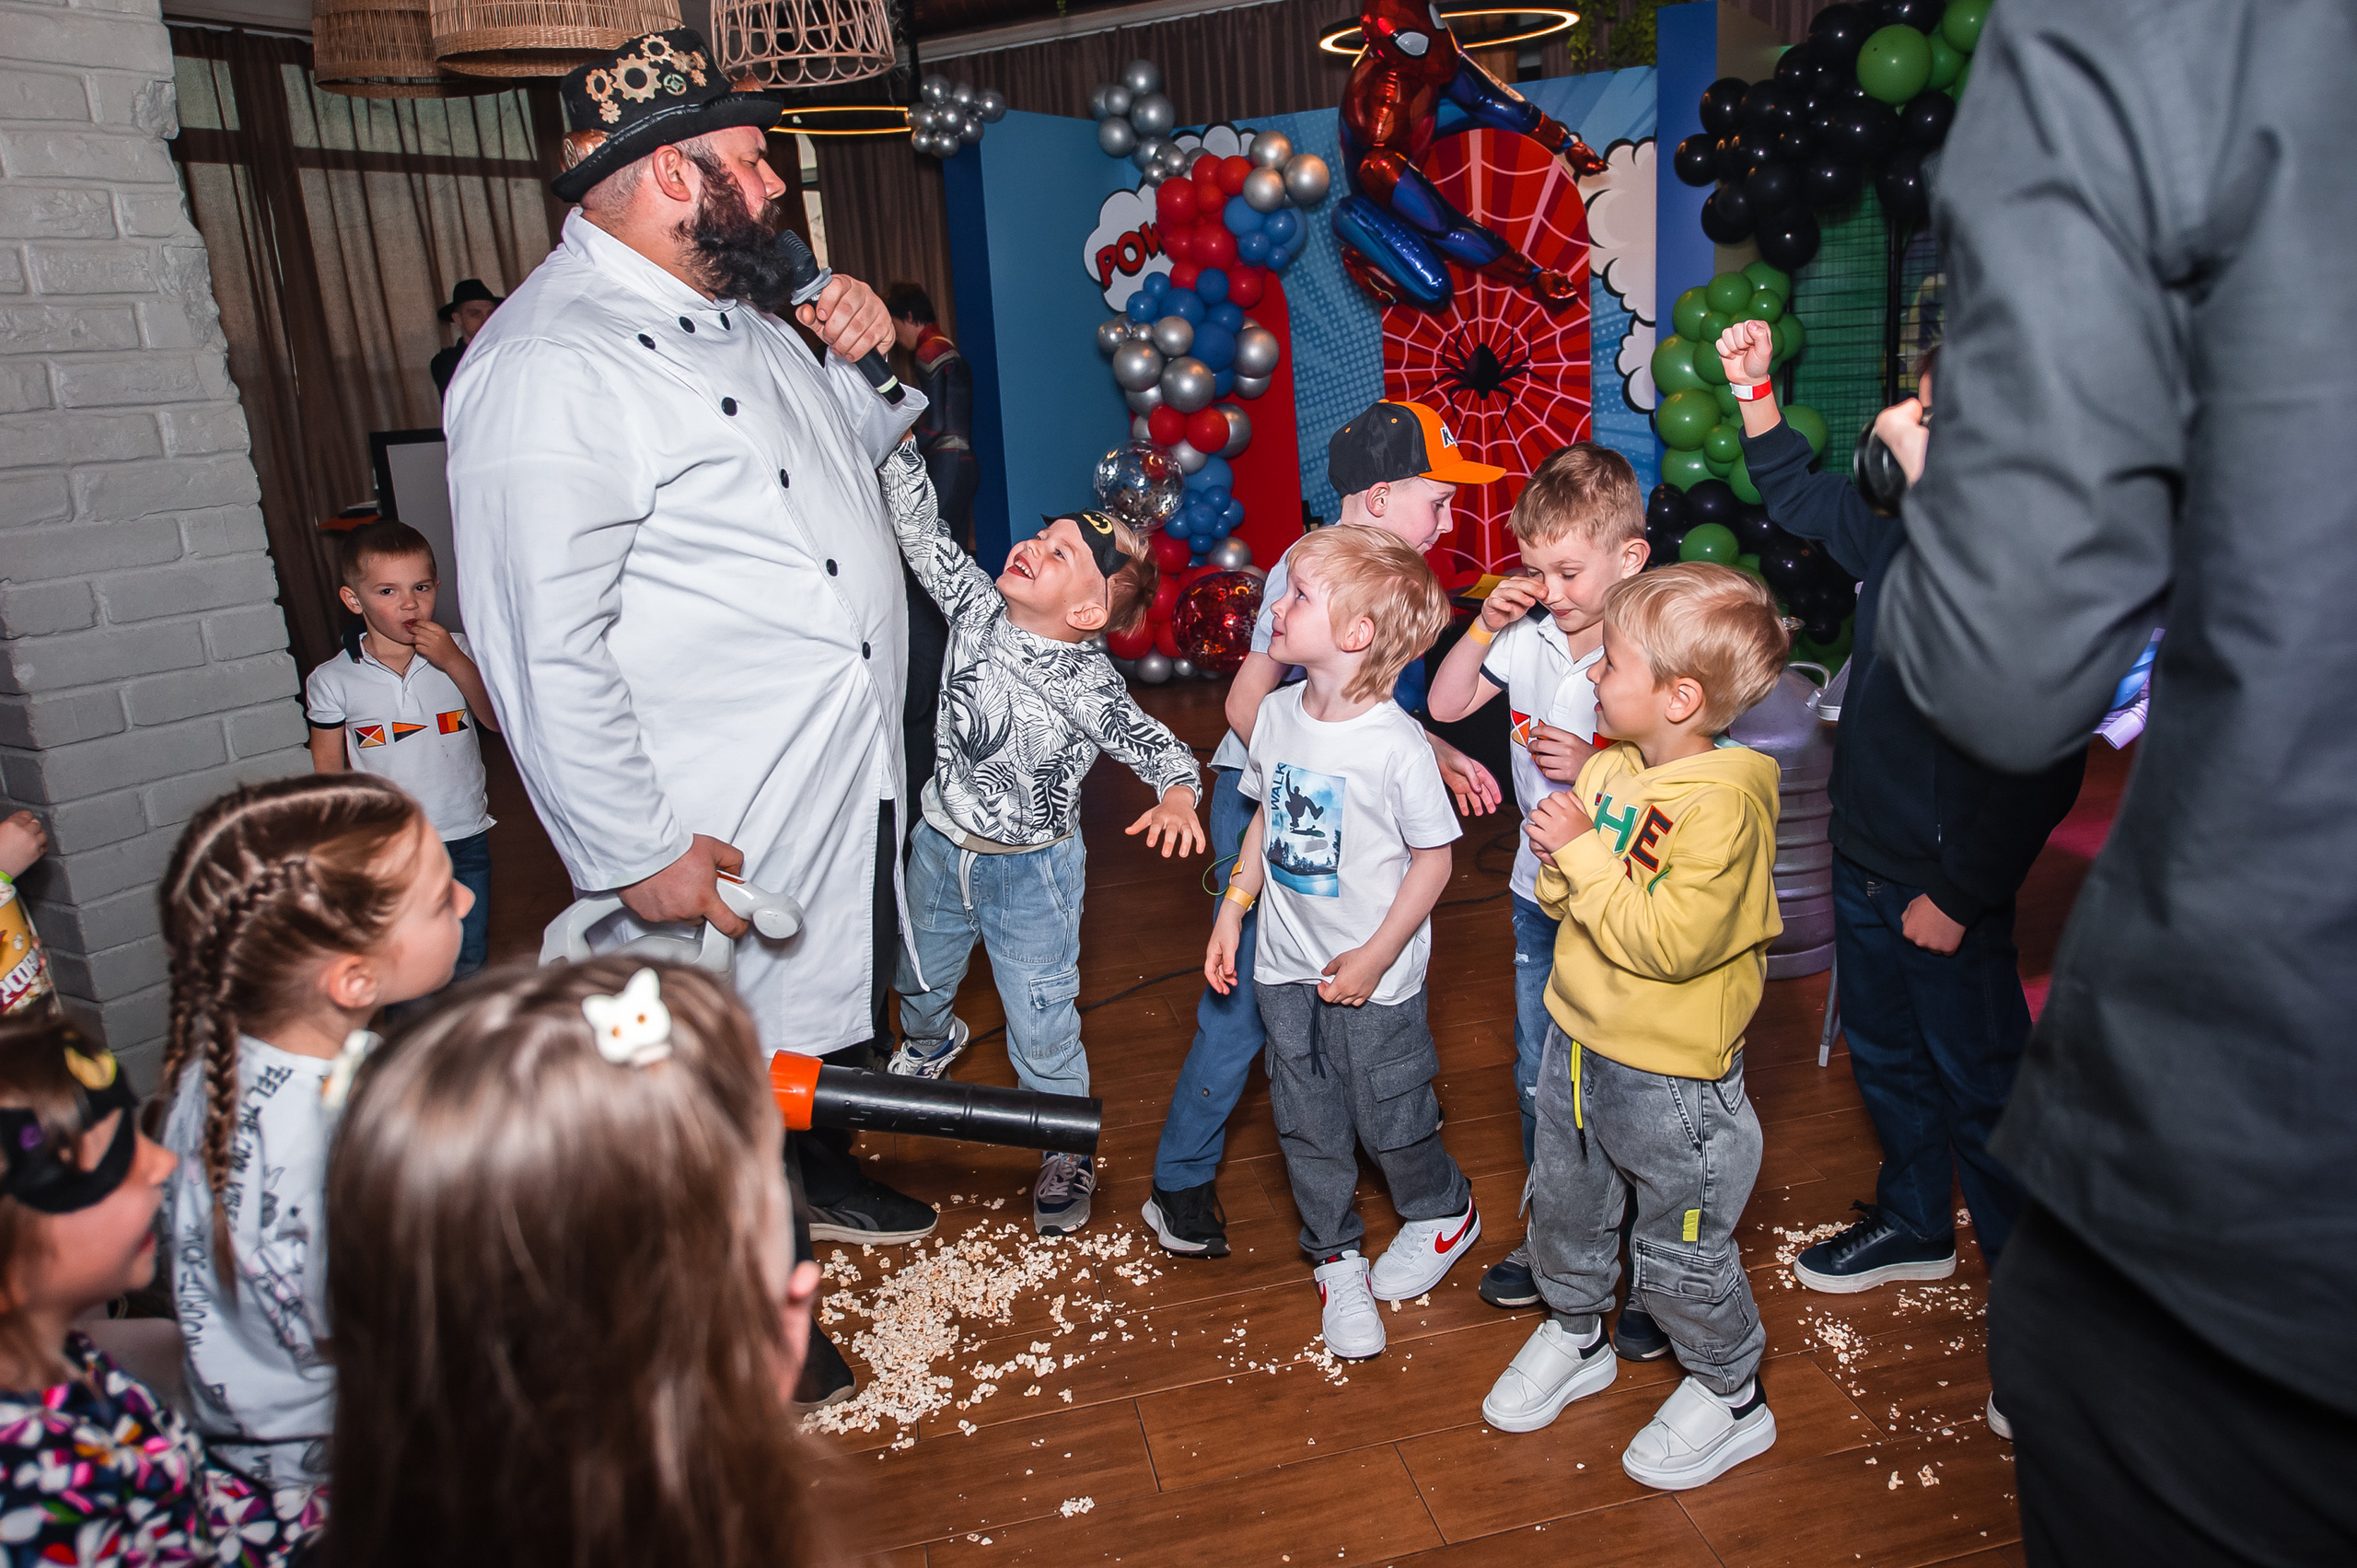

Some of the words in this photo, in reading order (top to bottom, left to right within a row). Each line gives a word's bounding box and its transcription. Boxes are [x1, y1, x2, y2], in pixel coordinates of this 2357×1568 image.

[1096, 221, 1166, 293] POW
[1271, 762, 1287, 811] WALK
[1594, 793, 1673, 873] HE
